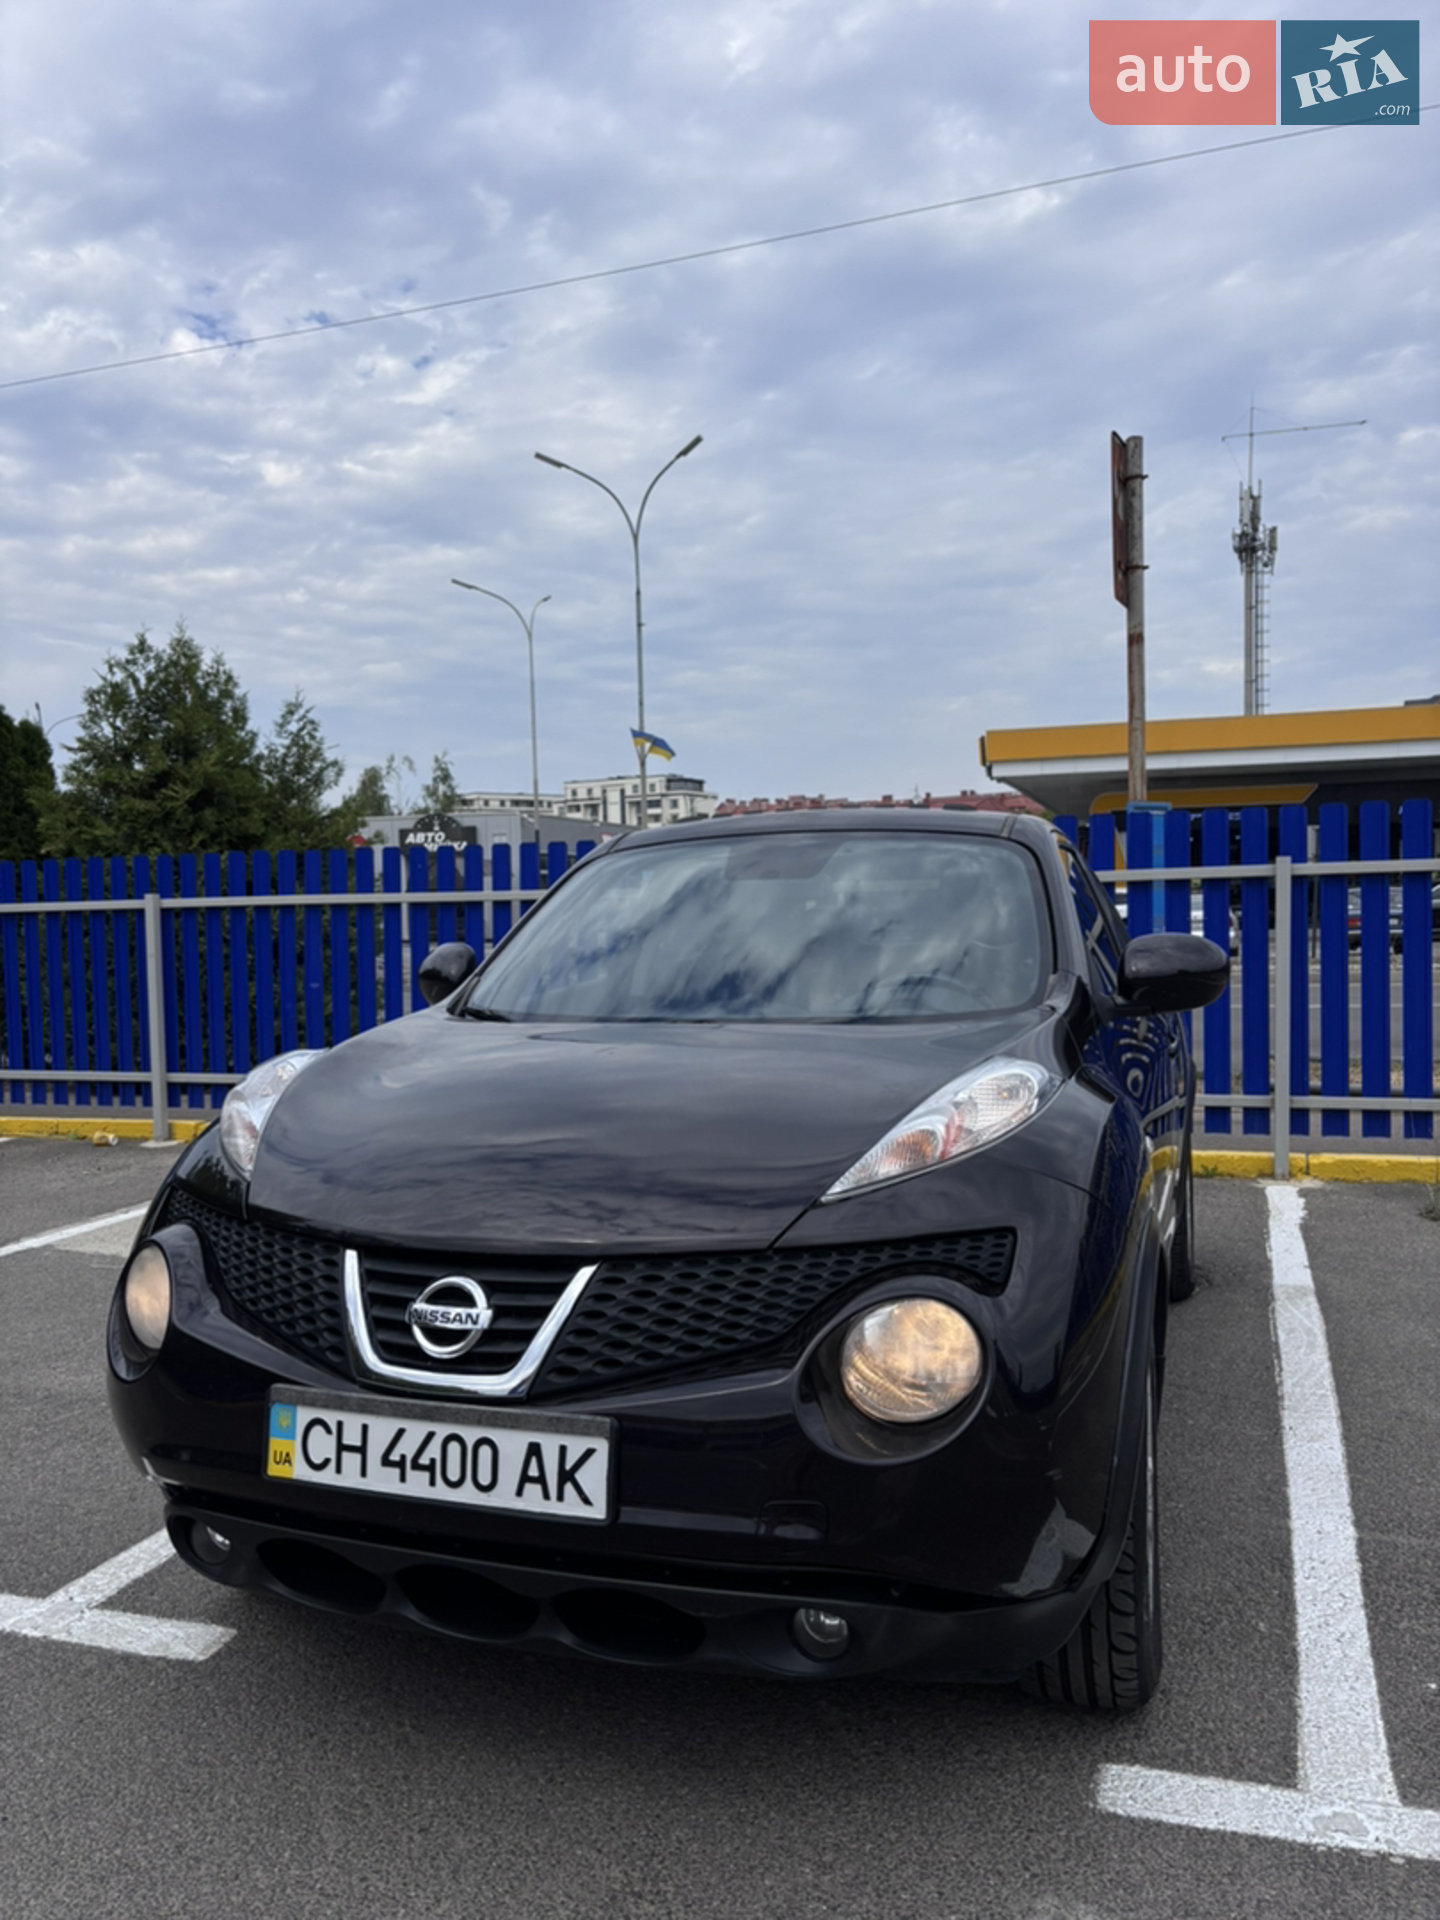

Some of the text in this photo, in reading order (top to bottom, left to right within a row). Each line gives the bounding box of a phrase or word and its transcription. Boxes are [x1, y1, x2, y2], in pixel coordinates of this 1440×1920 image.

[405, 831, 446, 844] АВТО
[410, 1308, 480, 1326] NISSAN
[273, 1450, 293, 1467] UA
[301, 1416, 598, 1507] CH 4400 AK
